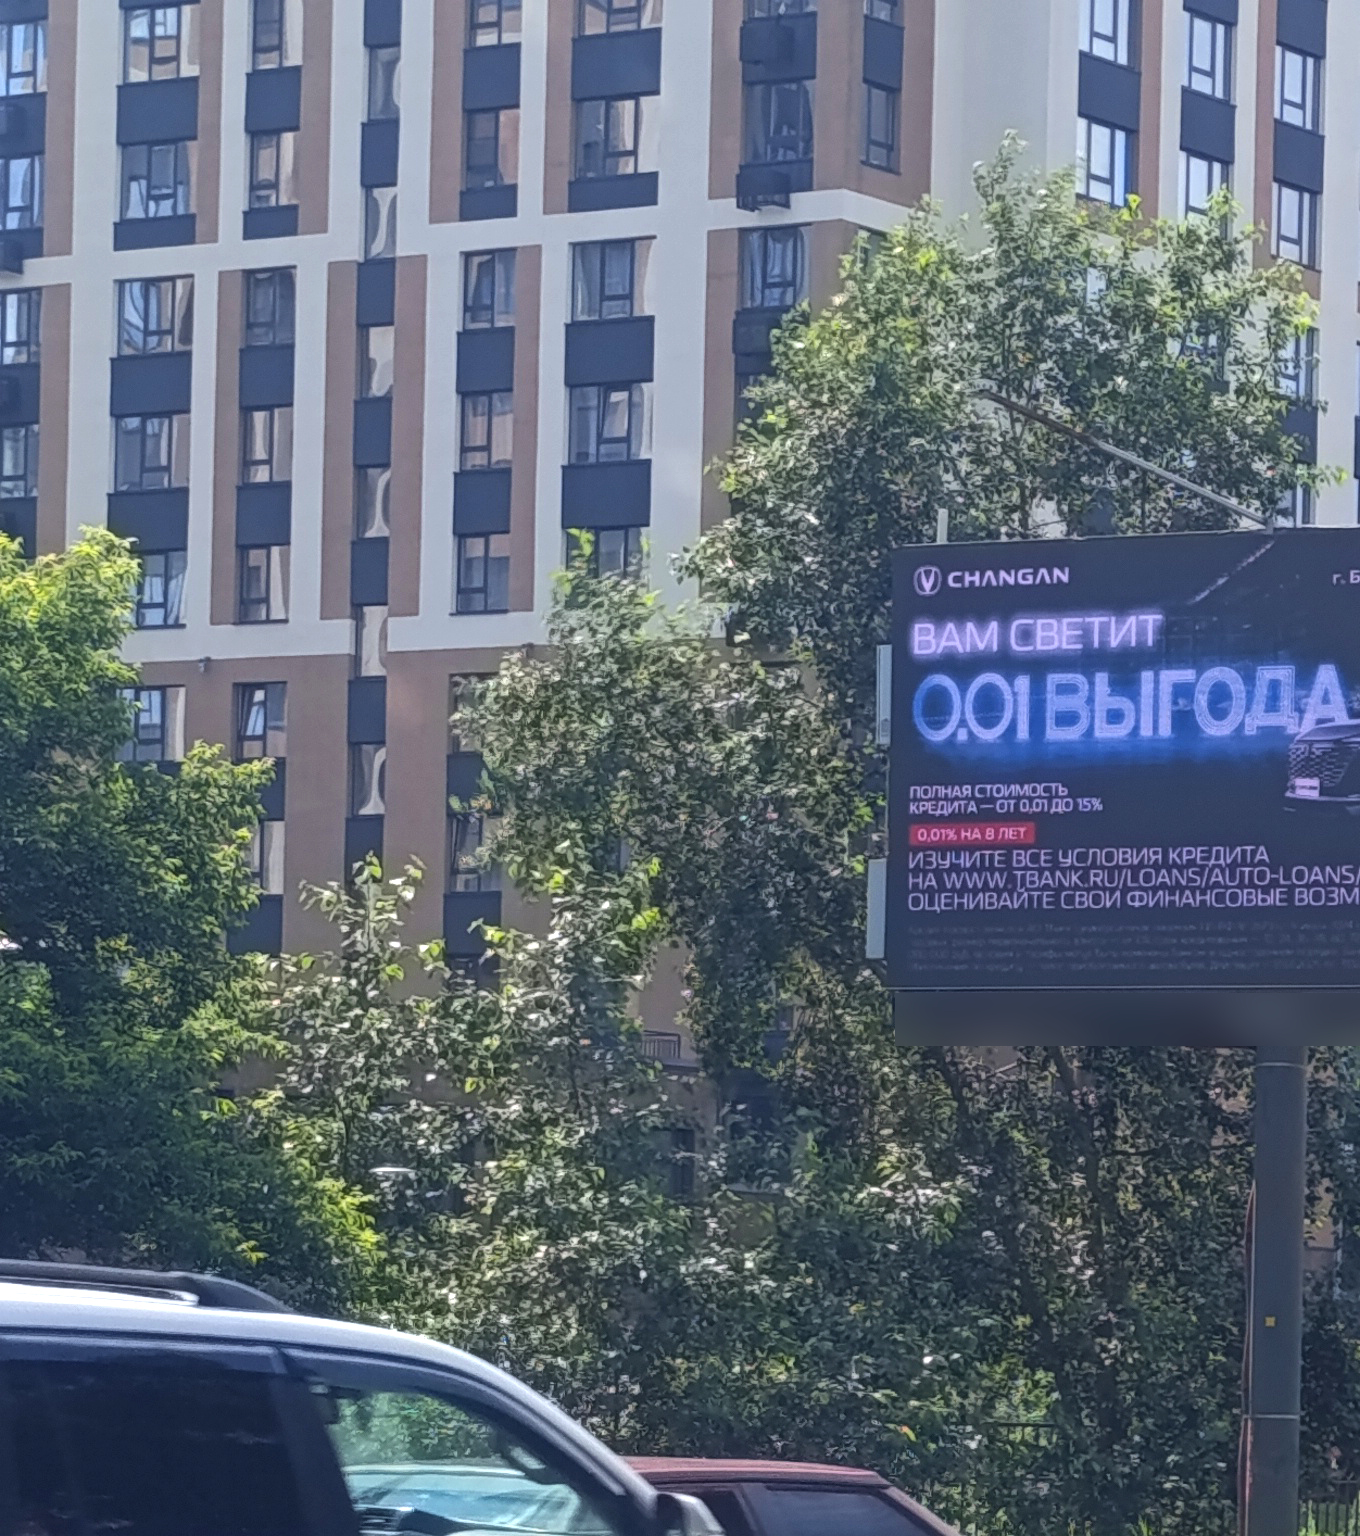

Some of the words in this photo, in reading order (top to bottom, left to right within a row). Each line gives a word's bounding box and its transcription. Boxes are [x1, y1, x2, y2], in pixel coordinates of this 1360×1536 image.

[947, 567, 1070, 588] CHANGAN
[1332, 573, 1346, 585] г.
[913, 621, 998, 655] ВАМ
[1009, 614, 1163, 651] СВЕТИТ
[913, 672, 1031, 742] 0.01
[1045, 664, 1349, 740] ВЫГОДА
[909, 785, 972, 799] ПОЛНАЯ
[975, 783, 1069, 797] СТОИМОСТЬ
[909, 800, 978, 816] КРЕДИТА
[996, 799, 1017, 813] ОТ
[1019, 799, 1049, 814] 0,01
[1050, 798, 1073, 814] ДО
[1077, 797, 1103, 812] 15%
[917, 828, 958, 843] 0,01%
[961, 828, 982, 841] НА
[985, 827, 994, 840] 8
[998, 826, 1027, 840] ЛЕТ
[909, 850, 1007, 869] ИЗУЧИТЕ
[1012, 849, 1052, 867] ВСЕ
[1058, 847, 1162, 867] УСЛОВИЯ
[1168, 846, 1270, 866] КРЕДИТА
[908, 872, 938, 890] НА
[908, 887, 1055, 914] ОЦЕНИВАЙТЕ
[1060, 890, 1121, 910] СВОИ
[1126, 887, 1288, 909] ФИНАНСОВЫЕ
